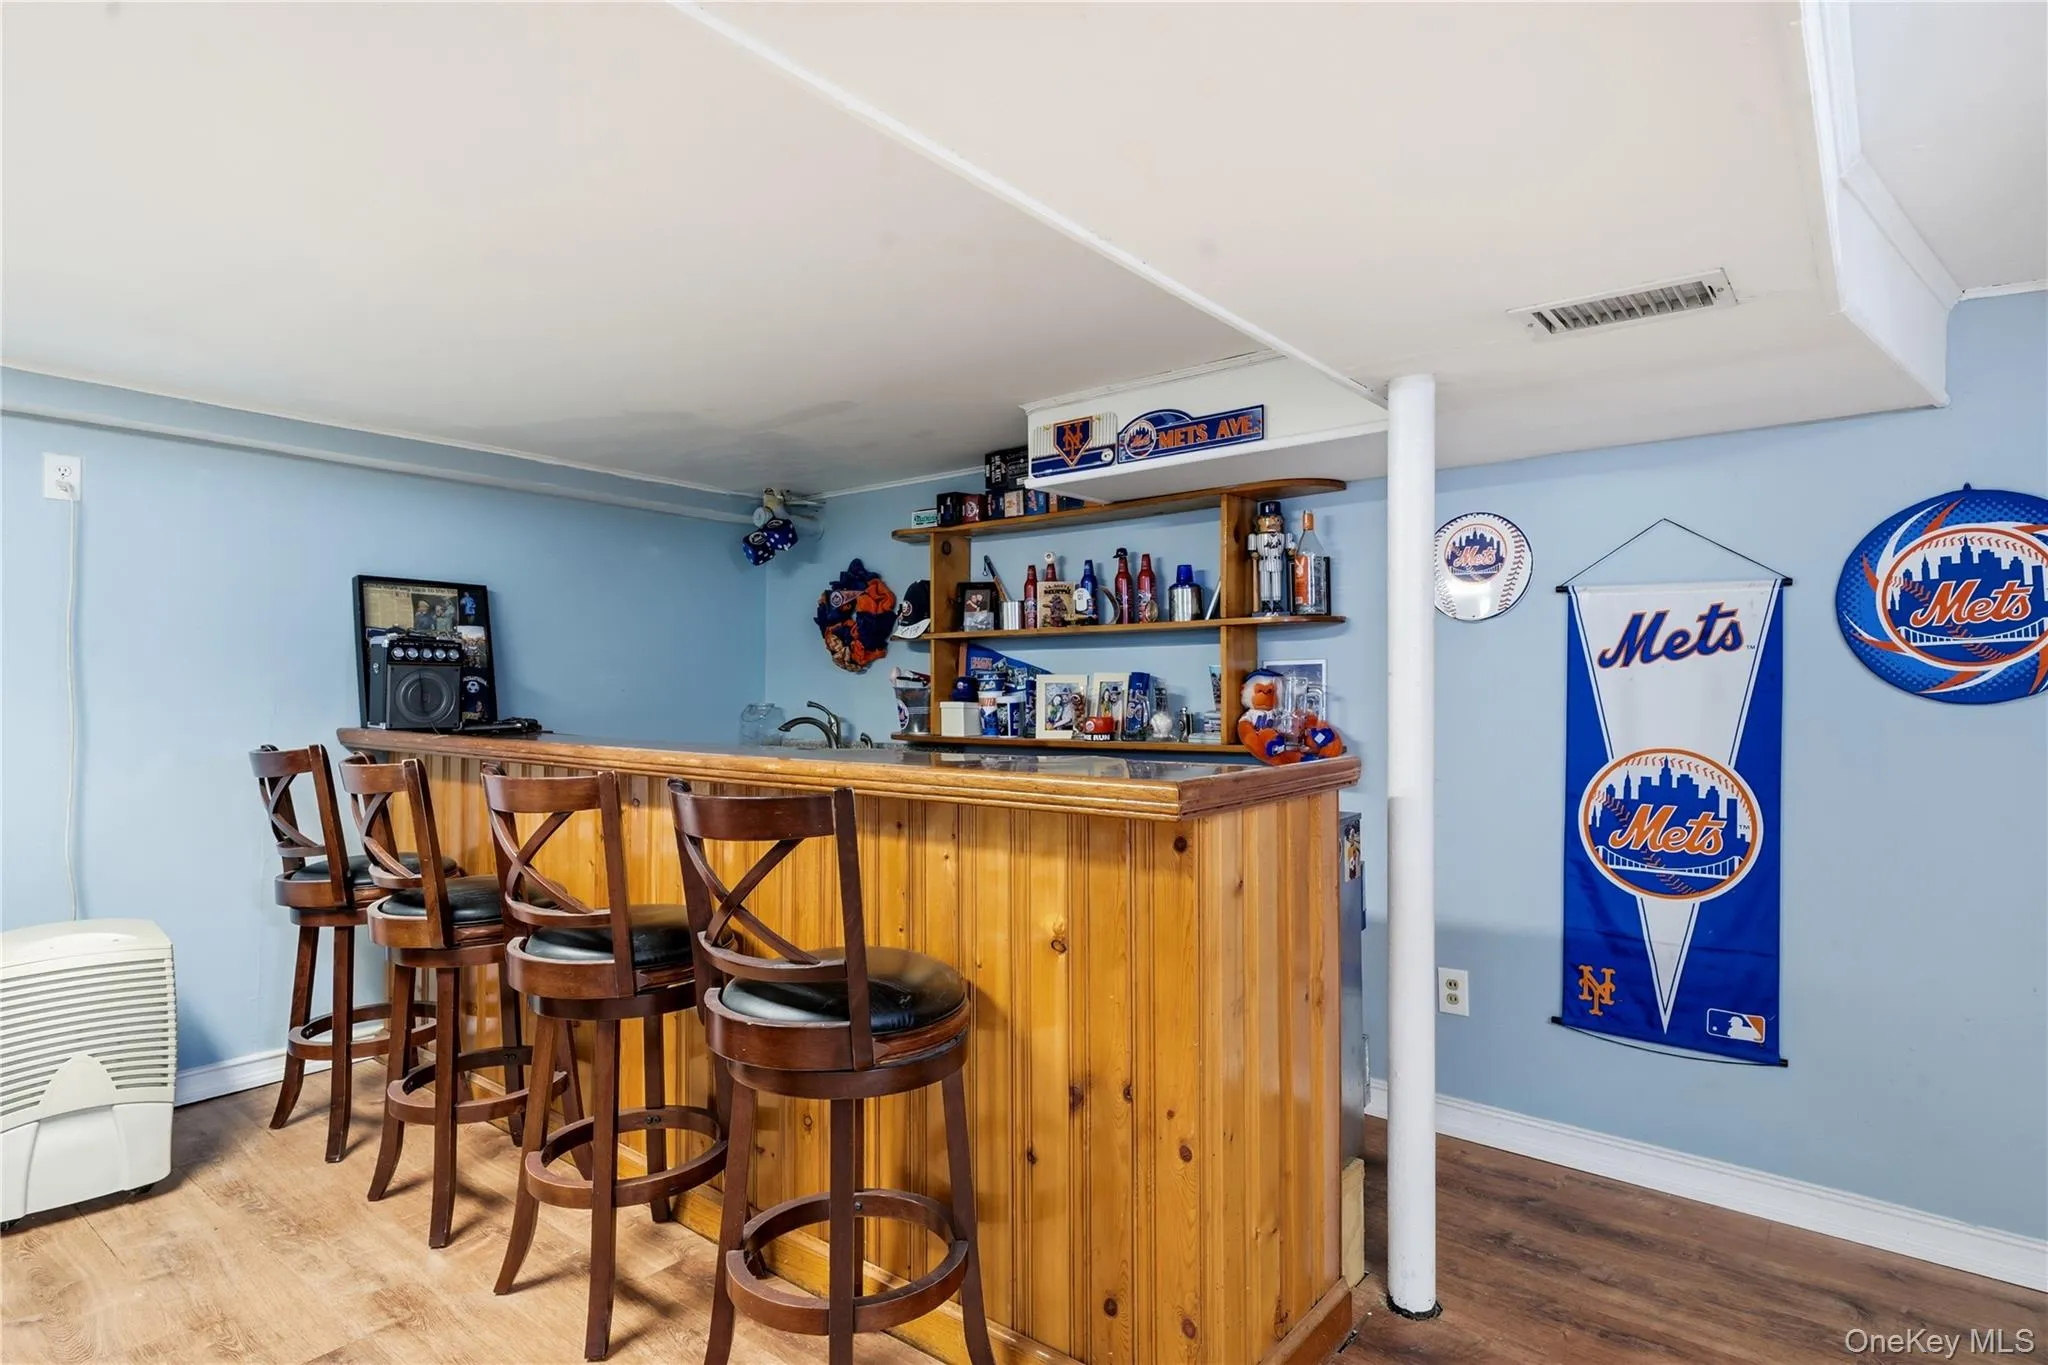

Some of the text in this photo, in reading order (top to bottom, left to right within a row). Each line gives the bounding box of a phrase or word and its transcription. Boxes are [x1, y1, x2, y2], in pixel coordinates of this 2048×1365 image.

[1158, 424, 1208, 449] METS
[1453, 545, 1497, 568] Mets
[1909, 578, 2034, 628] Mets
[1597, 602, 1745, 669] Mets
[1093, 733, 1111, 741] RUN
[1608, 803, 1729, 856] Mets
[1577, 964, 1615, 1016] NY
